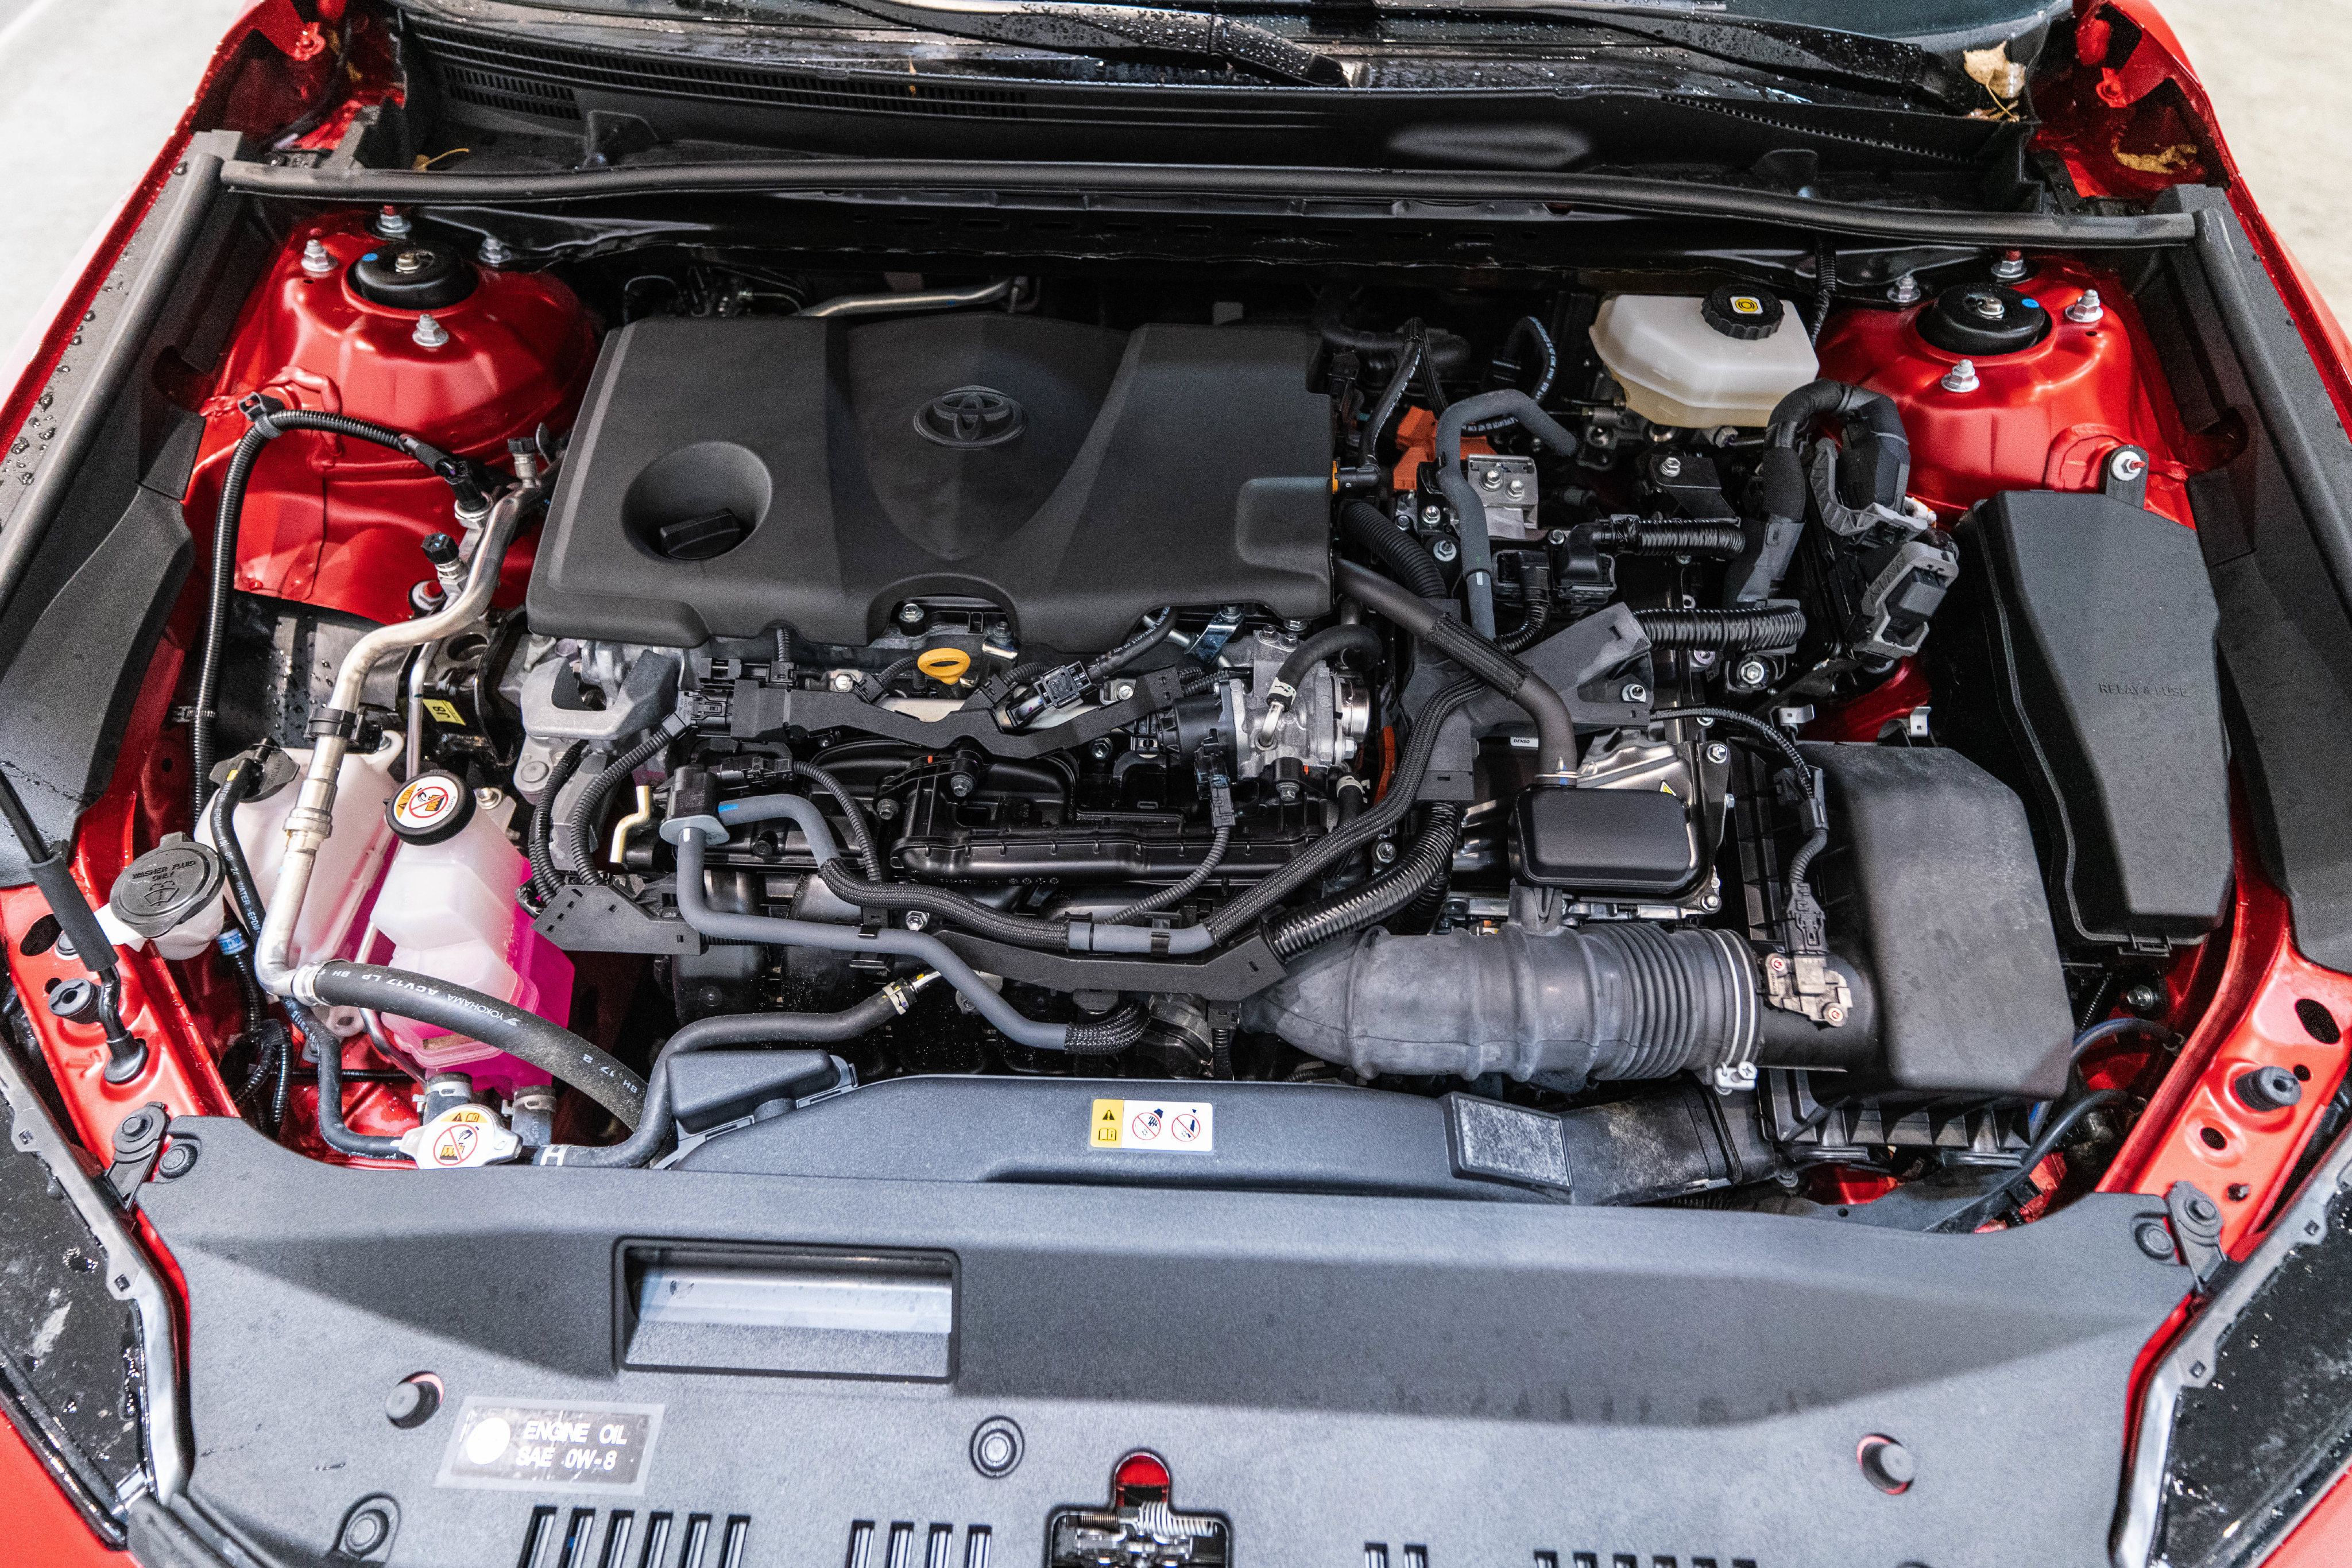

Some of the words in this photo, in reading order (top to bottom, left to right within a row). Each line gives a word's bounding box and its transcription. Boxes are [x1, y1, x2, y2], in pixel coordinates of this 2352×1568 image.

[2099, 683, 2140, 695] RELAY
[2142, 685, 2151, 695] &
[2154, 686, 2188, 697] FUSE
[132, 866, 168, 880] WASHER
[172, 861, 196, 870] FLUID
[152, 871, 175, 881] ONLY
[236, 880, 251, 906] WATER
[361, 974, 382, 982] LP
[385, 978, 440, 996] ACV17
[447, 993, 504, 1021] YOKOHAMA
[523, 1420, 591, 1444] ENGINE
[598, 1424, 628, 1446] OIL
[516, 1446, 556, 1468] SAE
[564, 1448, 618, 1471] 0W-8
